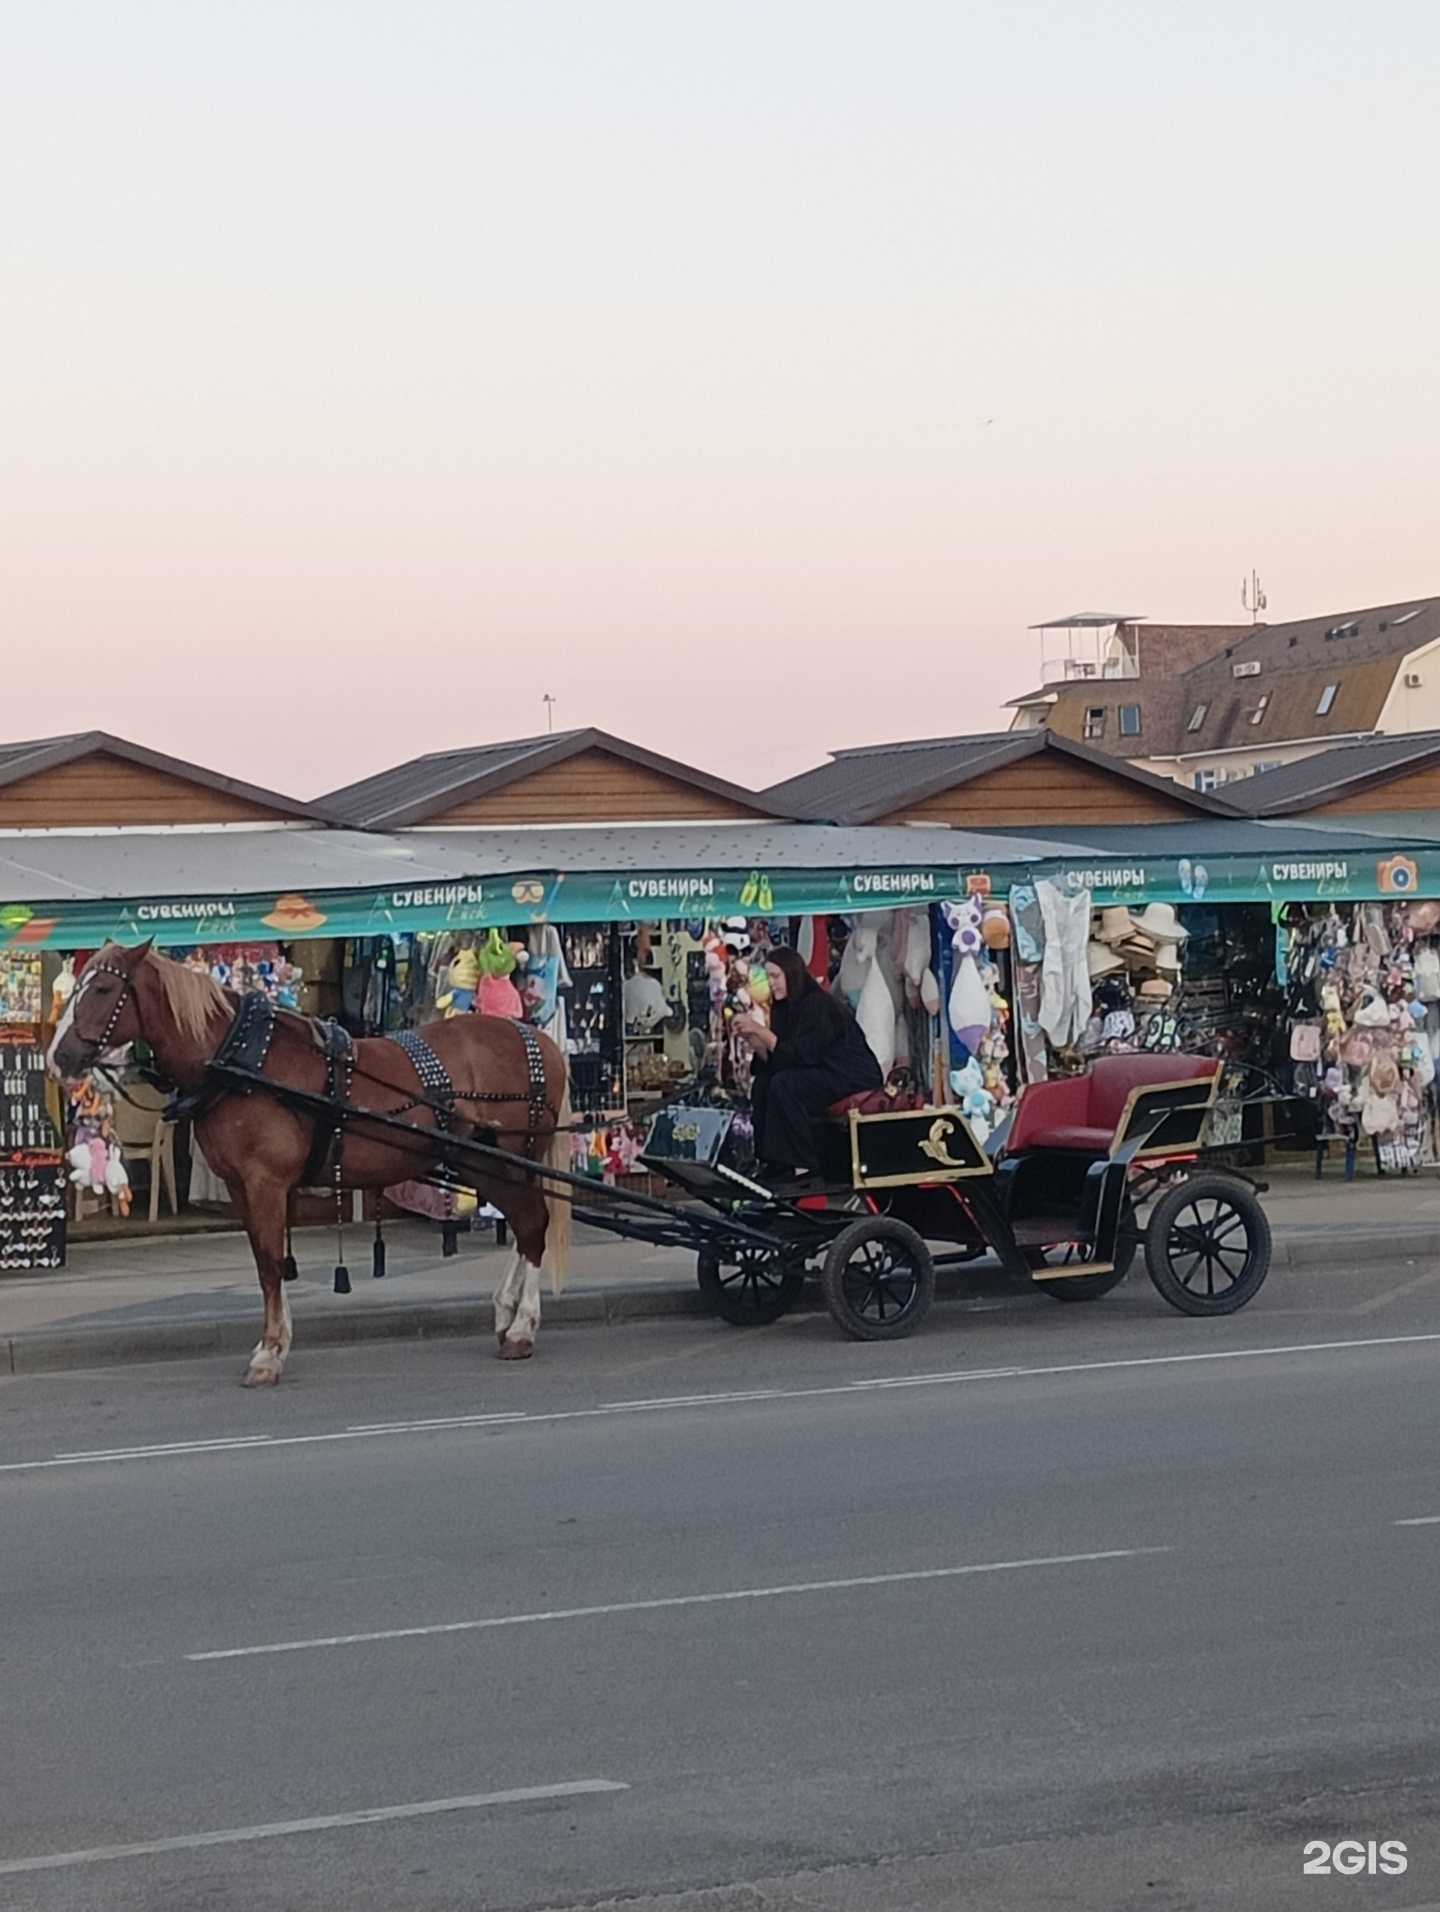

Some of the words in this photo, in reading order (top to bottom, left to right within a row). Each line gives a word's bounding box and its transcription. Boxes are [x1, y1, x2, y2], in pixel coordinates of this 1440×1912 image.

[1067, 868, 1145, 887] СУВЕНИРЫ
[1273, 861, 1347, 880] СУВЕНИРЫ
[628, 878, 713, 897] СУВЕНИРЫ
[853, 874, 934, 892] СУВЕНИРЫ
[393, 885, 482, 907] СУВЕНИРЫ
[138, 902, 235, 919] СУВЕНИРЫ
